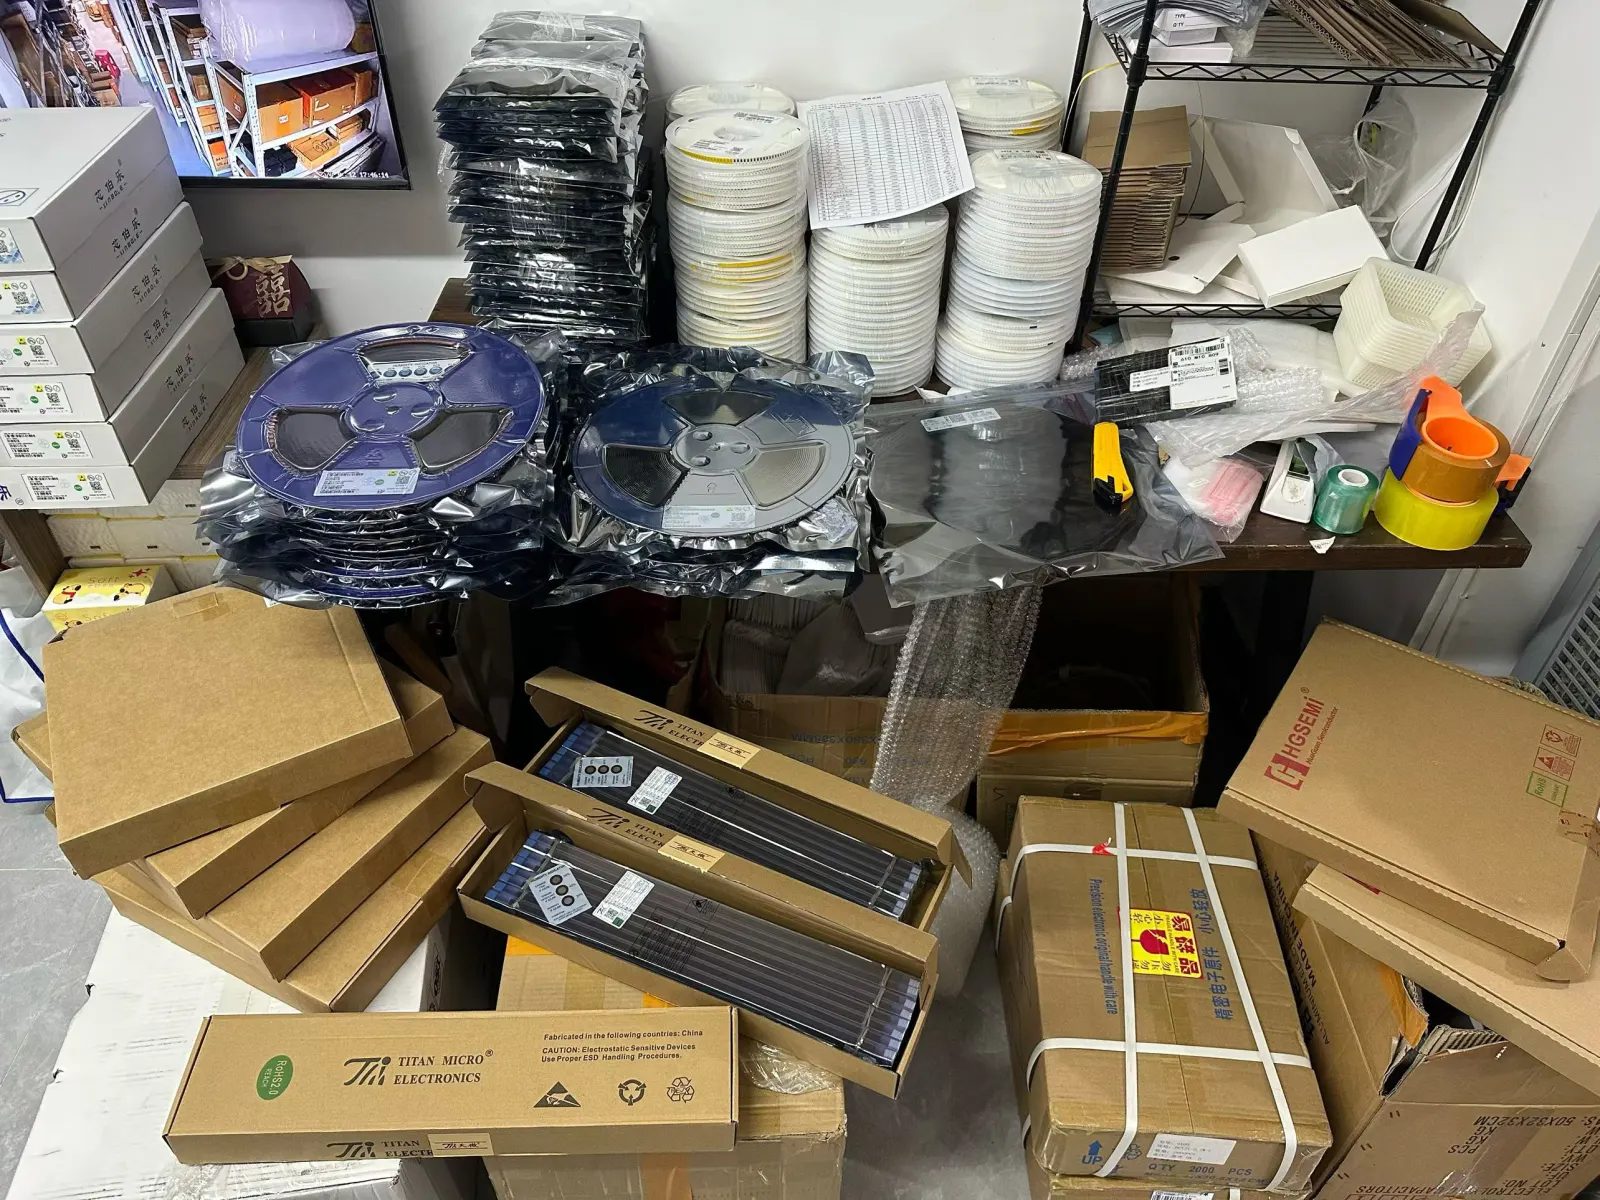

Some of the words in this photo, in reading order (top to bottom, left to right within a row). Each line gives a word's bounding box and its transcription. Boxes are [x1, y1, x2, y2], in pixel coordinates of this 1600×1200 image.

[95, 169, 125, 203] 芯伯乐
[112, 217, 141, 252] 芯伯乐
[131, 263, 161, 299] 芯伯乐
[143, 307, 171, 343] 芯伯乐
[165, 353, 194, 389] 芯伯乐
[181, 393, 208, 430] 芯伯乐
[677, 723, 705, 737] TITAN
[1305, 741, 1322, 765] HuaGuan
[1317, 706, 1338, 742] Semiconductor
[1534, 777, 1547, 797] RoHS
[634, 822, 665, 838] TITAN
[1090, 879, 1104, 906] Precision
[1274, 871, 1291, 919] CHINA
[1093, 906, 1106, 937] electronic
[1130, 912, 1164, 925] 小心轻
[1094, 937, 1111, 961] original
[1171, 915, 1199, 974] 易碎品
[1297, 939, 1316, 987] MADE
[1100, 962, 1113, 984] handle
[1104, 984, 1118, 1000] with
[1107, 1000, 1118, 1014] care
[543, 1033, 584, 1041] Fabricated
[607, 1032, 641, 1040] following
[642, 1030, 681, 1038] countries:
[581, 1045, 630, 1053] Electrostatic
[630, 1044, 666, 1052] Sensitive
[666, 1043, 696, 1051] Devices
[398, 1055, 435, 1067] TITAN
[441, 1054, 484, 1065] MICRO
[541, 1055, 555, 1063] Use
[556, 1055, 582, 1063] Proper
[602, 1053, 635, 1061] Handling
[637, 1052, 682, 1060] Procedures.
[261, 1068, 273, 1088] REACH
[268, 1060, 287, 1095] RoHS2.0
[393, 1072, 481, 1085] ELECTRONICS
[1473, 1116, 1576, 1125] 50X32X32CM
[1473, 1126, 1497, 1135] KG
[1464, 1134, 1488, 1144] KG
[1447, 1144, 1479, 1153] PCS
[1562, 1144, 1598, 1153] QTY:
[1081, 1155, 1103, 1164] UP
[1560, 1153, 1587, 1162] WV:
[1188, 1166, 1215, 1174] 2000
[1227, 1168, 1253, 1176] PCS
[1540, 1162, 1578, 1171] SIZE:
[1545, 1170, 1570, 1179] UF:
[1501, 1179, 1528, 1188] NO:
[1529, 1179, 1561, 1188] LOT
